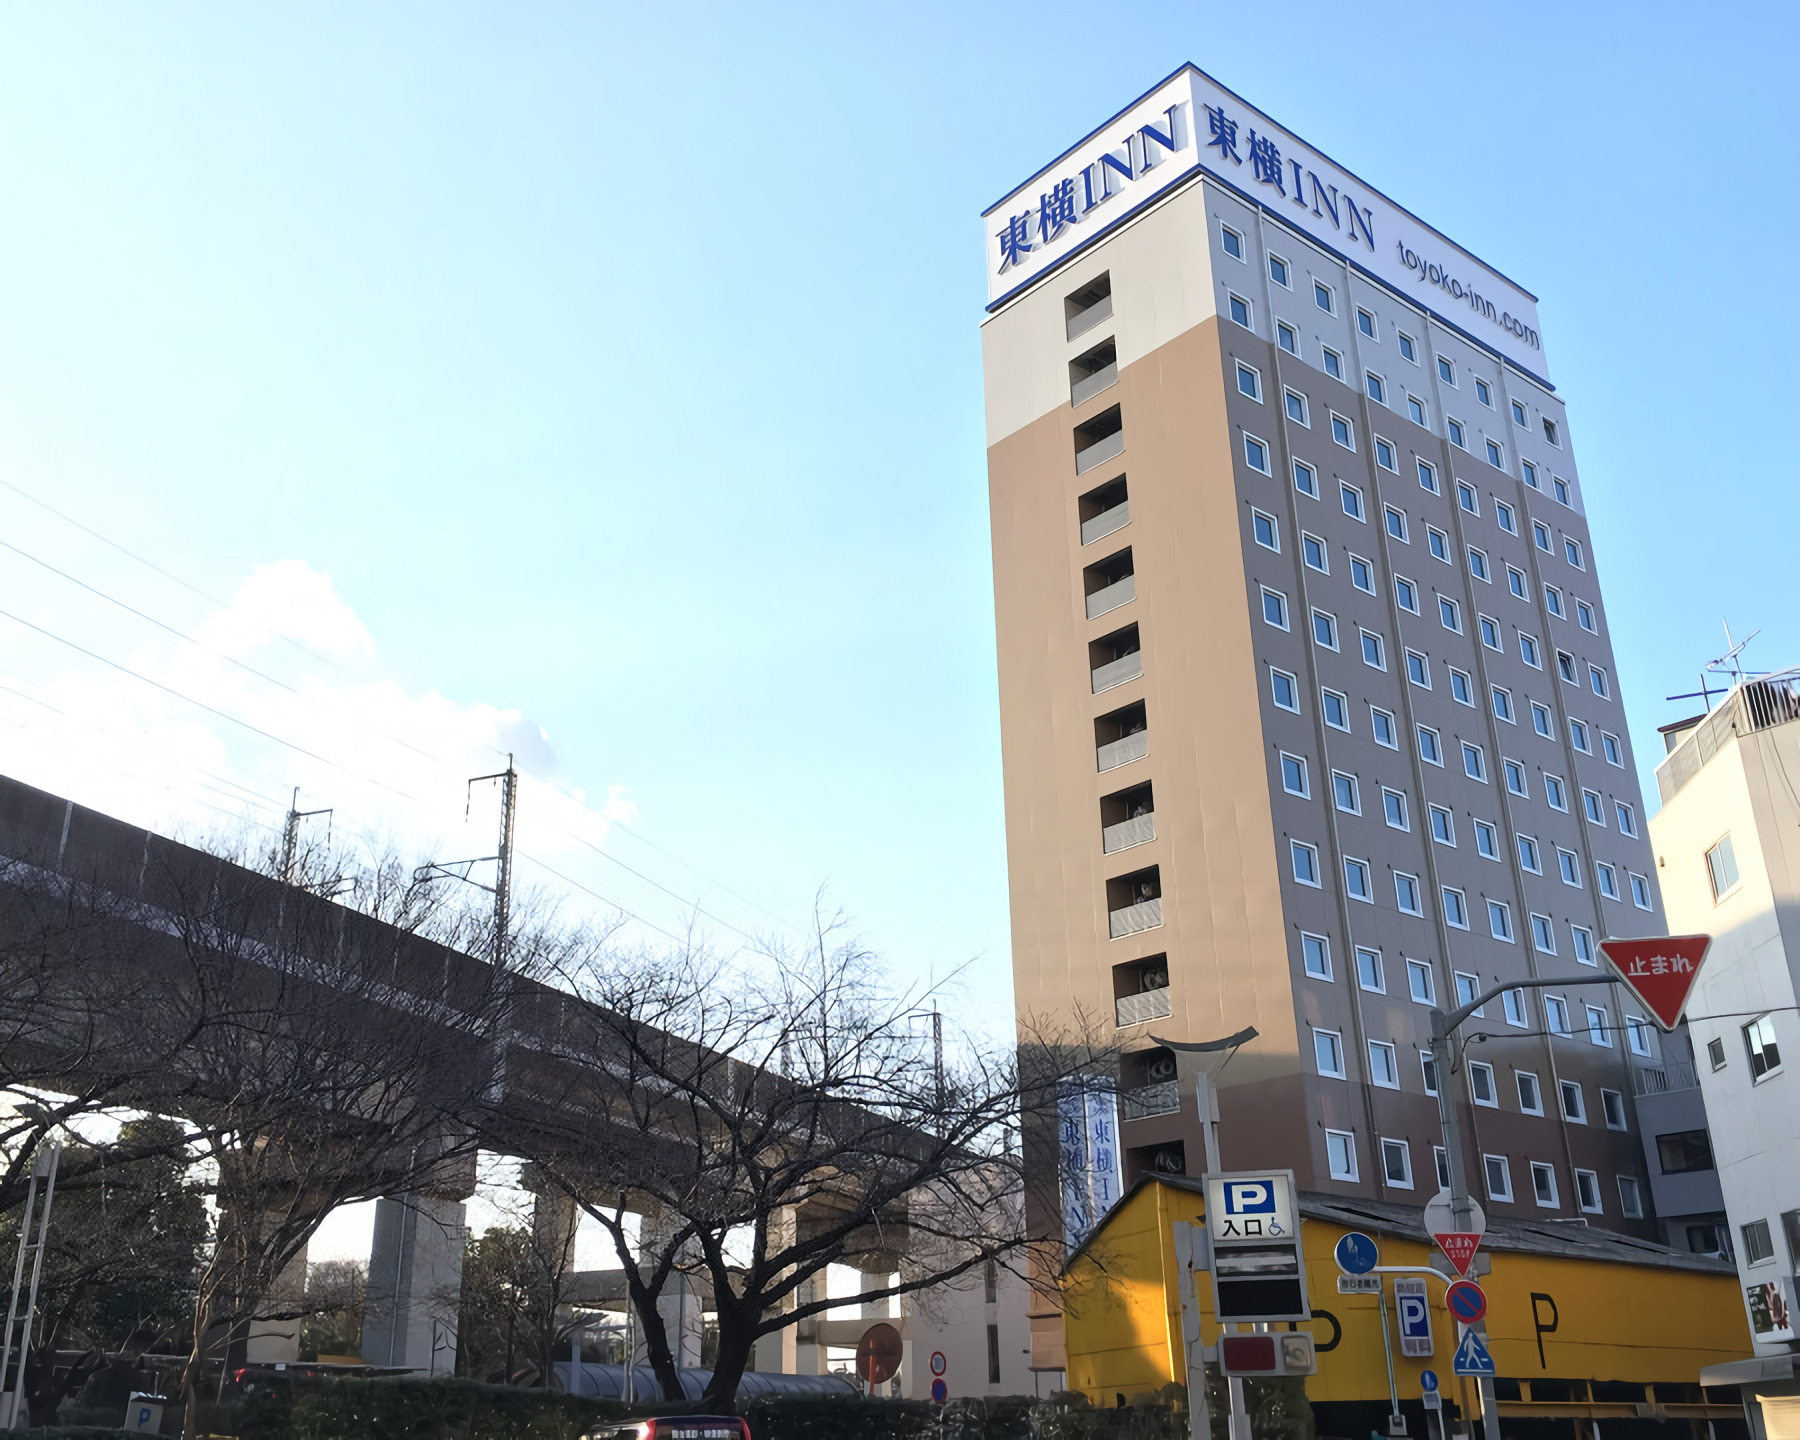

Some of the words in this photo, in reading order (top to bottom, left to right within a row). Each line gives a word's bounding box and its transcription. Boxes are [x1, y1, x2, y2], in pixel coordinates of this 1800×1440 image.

[995, 104, 1176, 275] 東横INN
[1203, 103, 1375, 252] 東横INN
[1397, 240, 1540, 350] toyoko-inn.com
[1628, 953, 1694, 976] 止まれ
[1231, 1184, 1267, 1213] P
[1222, 1219, 1262, 1237] 入口
[1401, 1299, 1425, 1335] P
[1530, 1292, 1558, 1370] P
